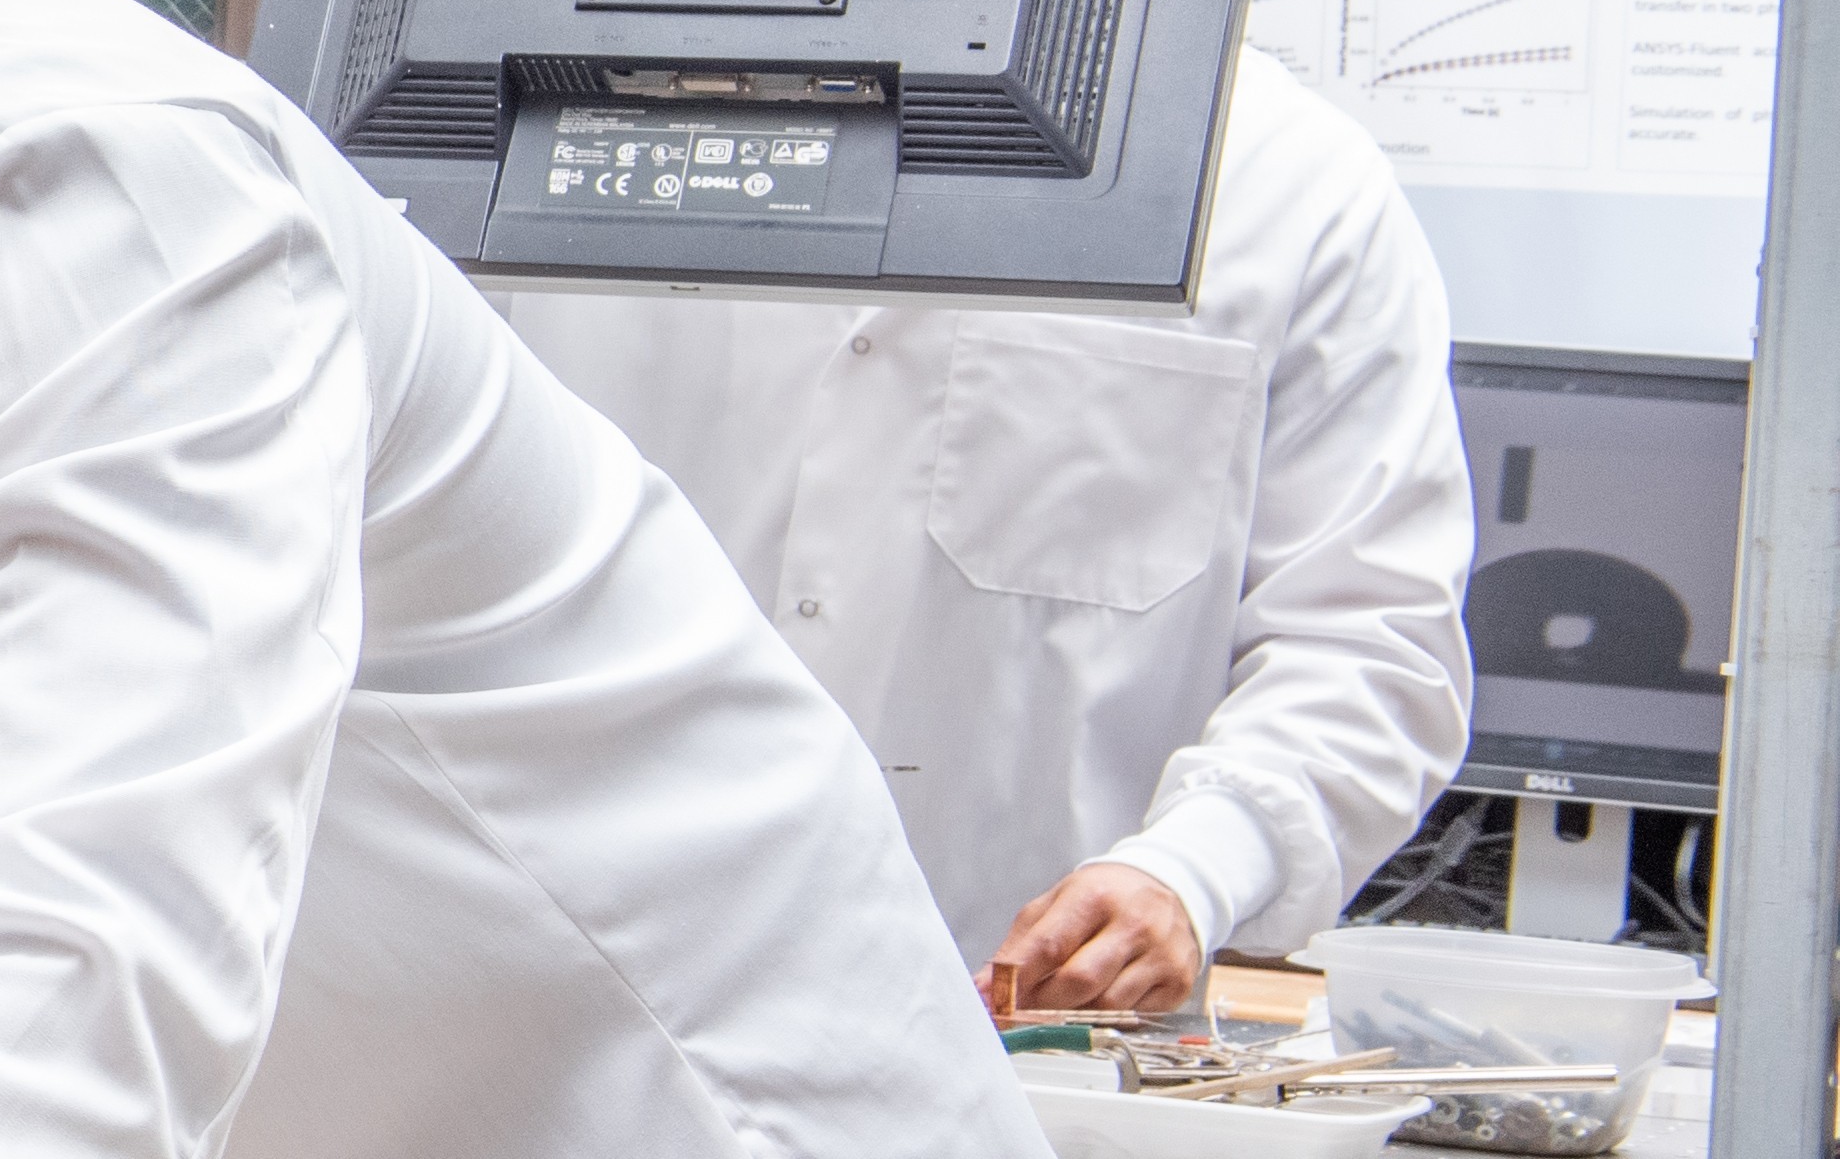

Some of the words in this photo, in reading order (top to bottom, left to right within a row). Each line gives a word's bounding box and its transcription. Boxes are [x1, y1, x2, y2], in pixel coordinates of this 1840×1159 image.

[1634, 0, 1696, 13] transfer
[1629, 105, 1715, 121] Simulation
[1525, 773, 1575, 793] DELL
